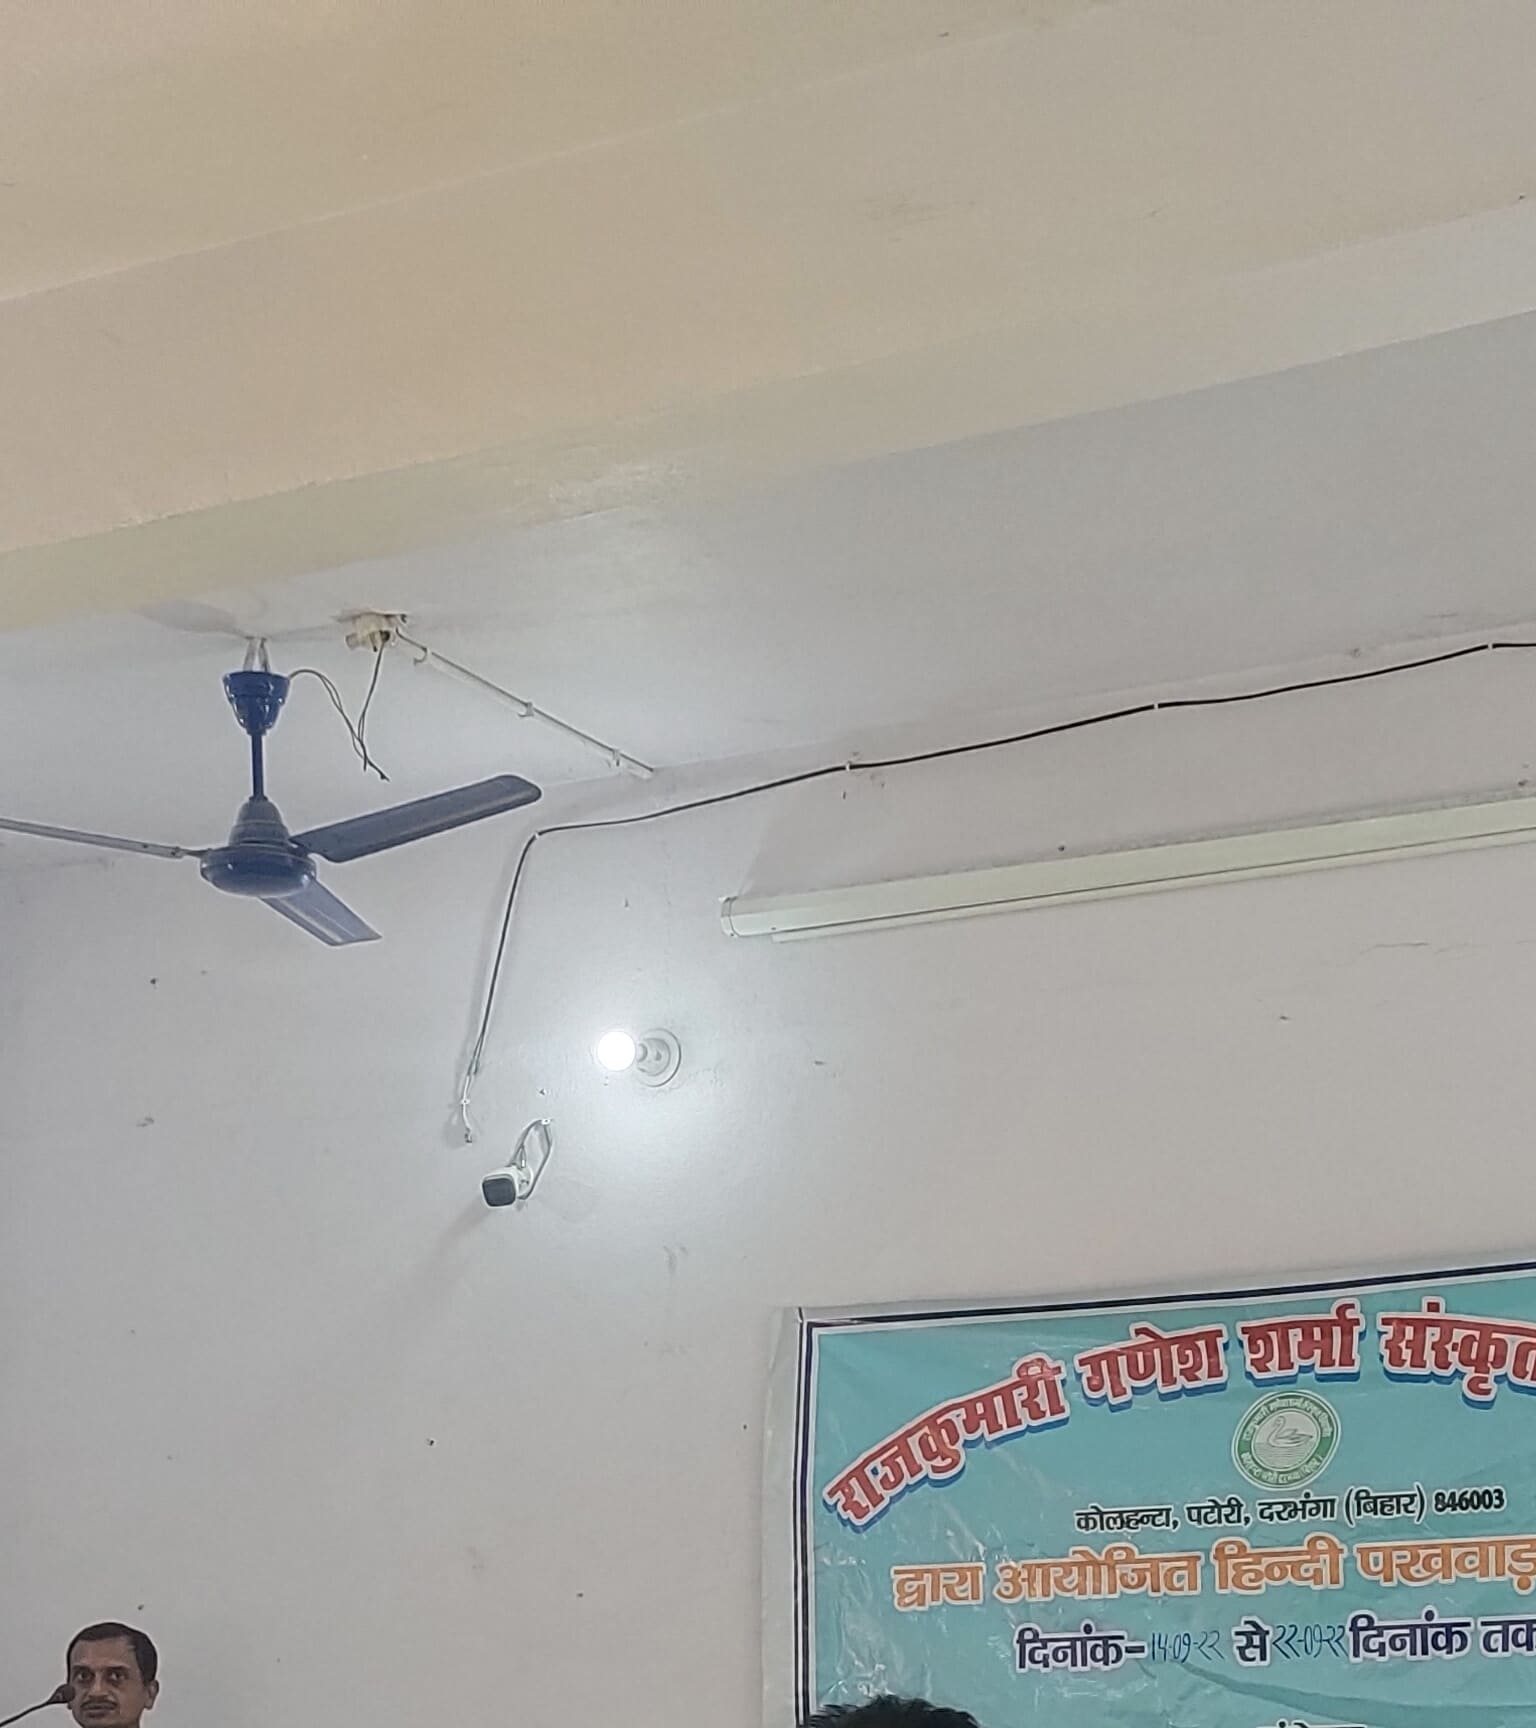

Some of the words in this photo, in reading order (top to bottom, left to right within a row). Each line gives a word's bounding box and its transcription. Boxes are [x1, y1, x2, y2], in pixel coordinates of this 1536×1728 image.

[824, 1355, 1068, 1523] राजकुमारी
[1075, 1324, 1225, 1401] गणेश
[1239, 1300, 1362, 1375] शर्मा
[1186, 1496, 1250, 1527] पटोरी,
[1258, 1492, 1336, 1521] दरभंगा
[1344, 1487, 1425, 1523] (बिहार)
[1433, 1488, 1505, 1513] 846003
[892, 1564, 985, 1609] द्वारा
[995, 1545, 1202, 1600] आयोजित
[1212, 1535, 1345, 1594] हिन्दी
[1232, 1618, 1271, 1664] से
[1348, 1606, 1472, 1659] दिनांक
